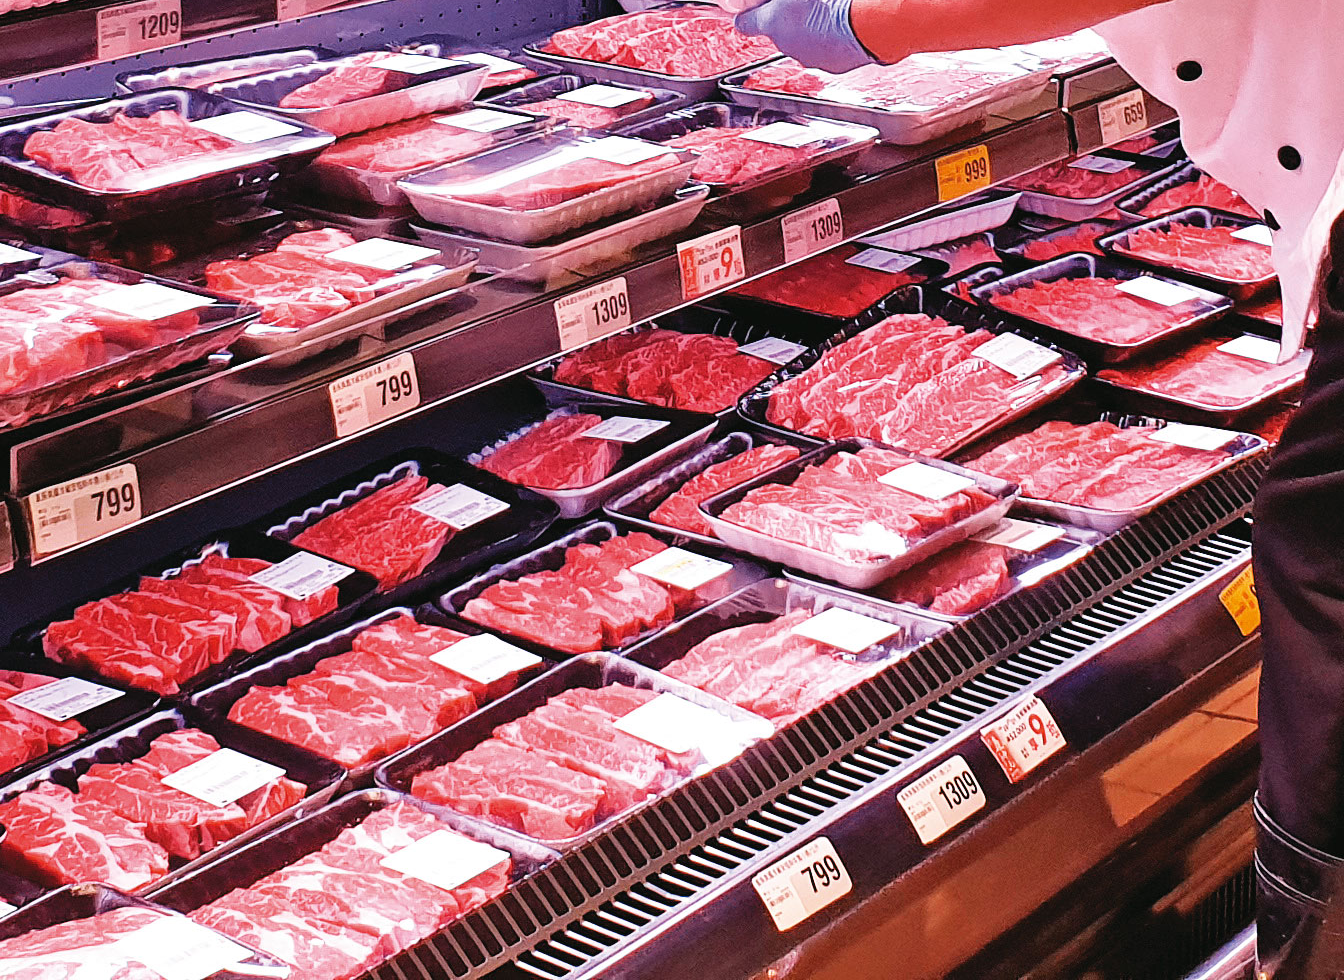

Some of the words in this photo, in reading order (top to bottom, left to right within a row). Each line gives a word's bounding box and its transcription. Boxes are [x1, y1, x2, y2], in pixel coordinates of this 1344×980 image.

[138, 10, 180, 40] 1209
[1124, 101, 1144, 126] 659
[964, 158, 987, 183] 999
[811, 211, 841, 242] 1309
[720, 246, 734, 278] 9
[592, 292, 627, 326] 1309
[376, 370, 412, 407] 799
[91, 482, 135, 522] 799
[1028, 713, 1047, 746] 9
[939, 770, 978, 810] 1309
[801, 854, 841, 893] 799
